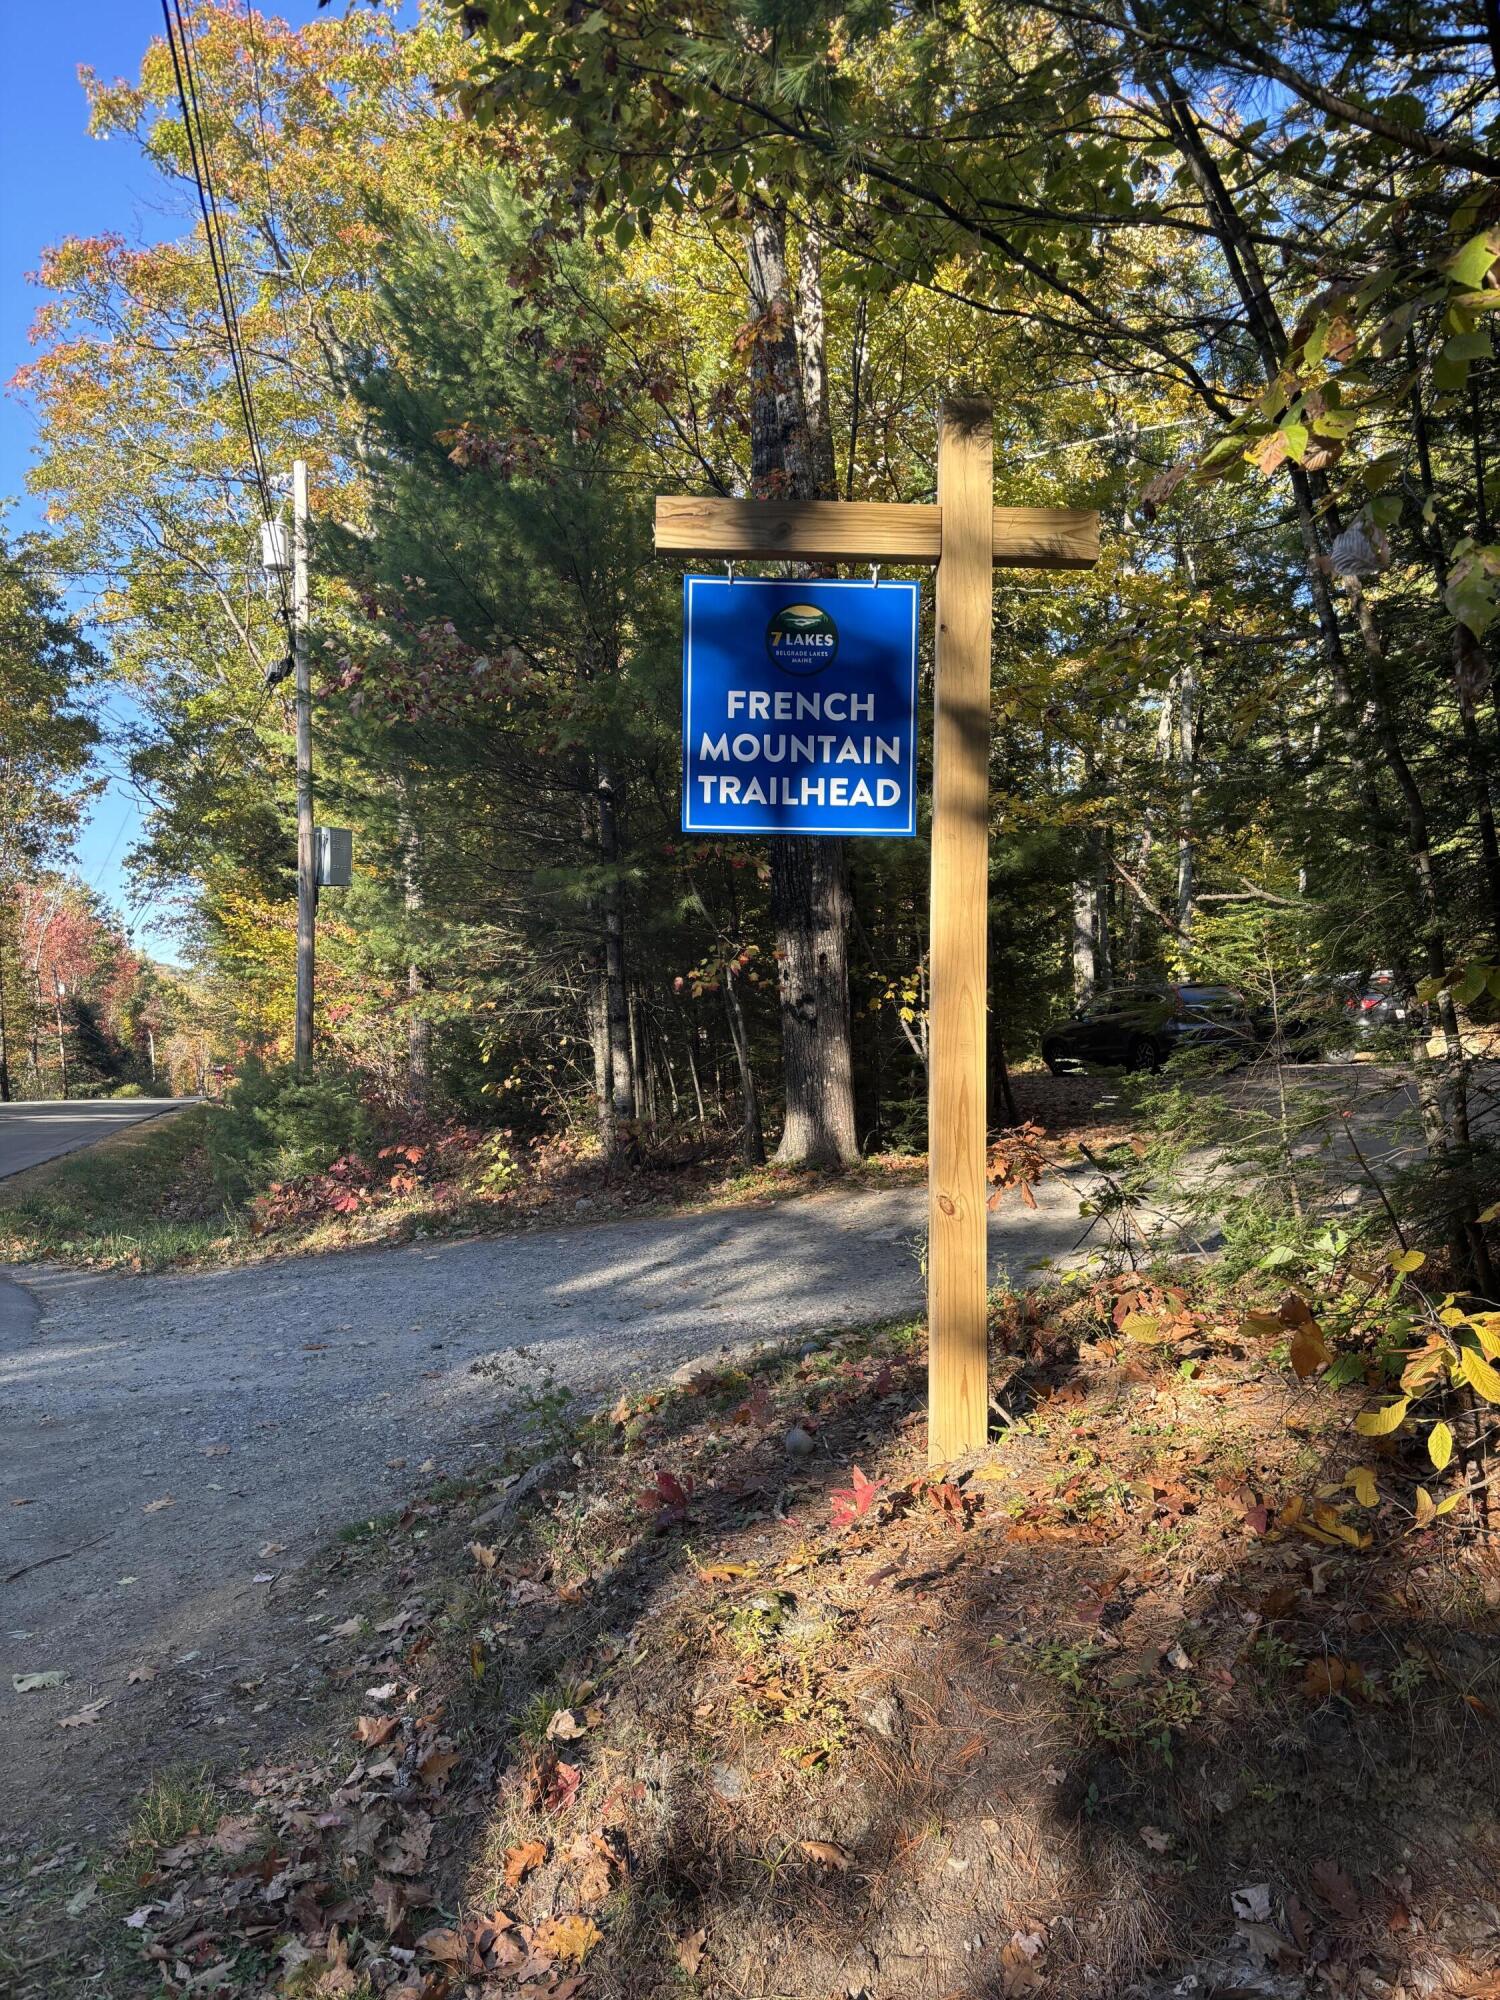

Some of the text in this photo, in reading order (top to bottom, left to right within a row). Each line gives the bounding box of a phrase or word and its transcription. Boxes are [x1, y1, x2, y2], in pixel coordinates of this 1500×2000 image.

[771, 632, 834, 646] 7 LAKES
[727, 690, 875, 721] FRENCH
[699, 732, 900, 764] MOUNTAIN
[698, 775, 901, 807] TRAILHEAD
